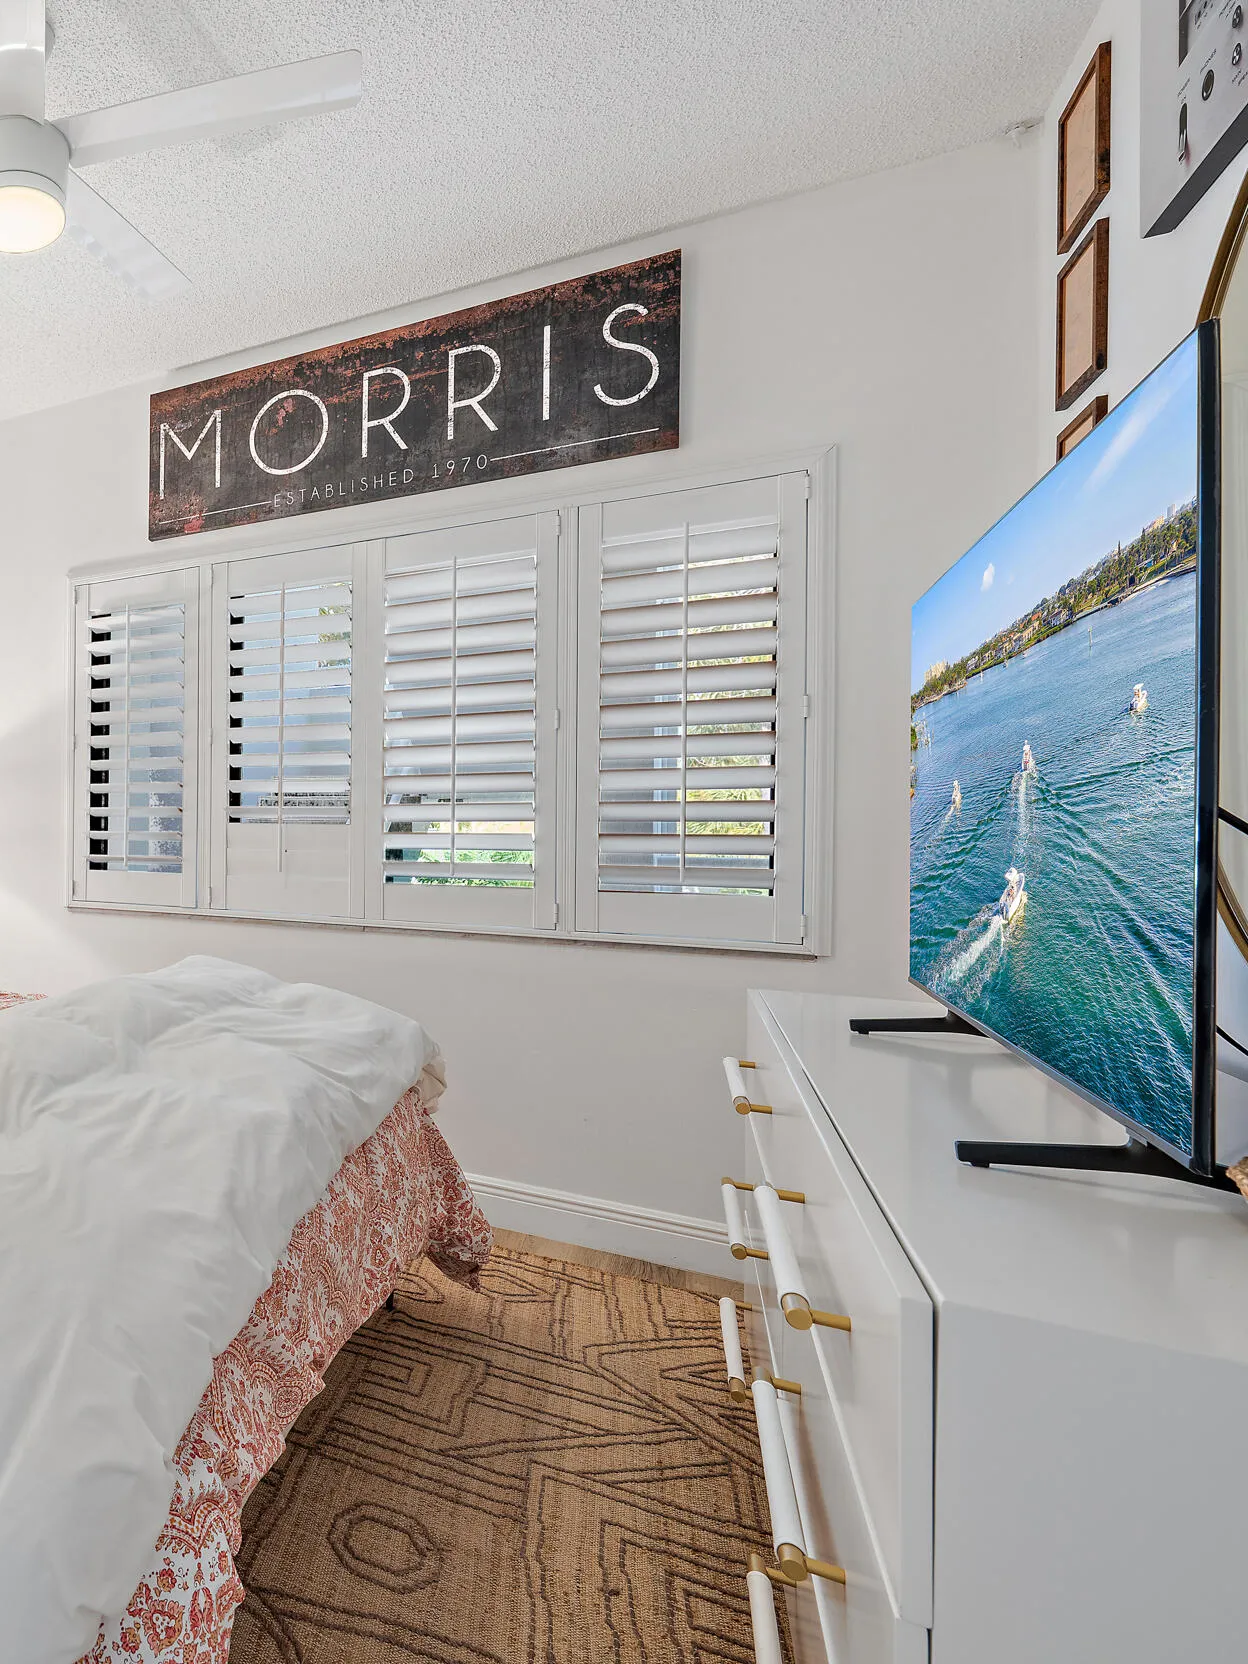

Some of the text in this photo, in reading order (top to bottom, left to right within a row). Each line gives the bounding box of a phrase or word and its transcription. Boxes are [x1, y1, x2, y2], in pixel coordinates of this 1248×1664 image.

[158, 302, 661, 500] MORRIS
[272, 452, 488, 508] ESTABLISHED 1970
